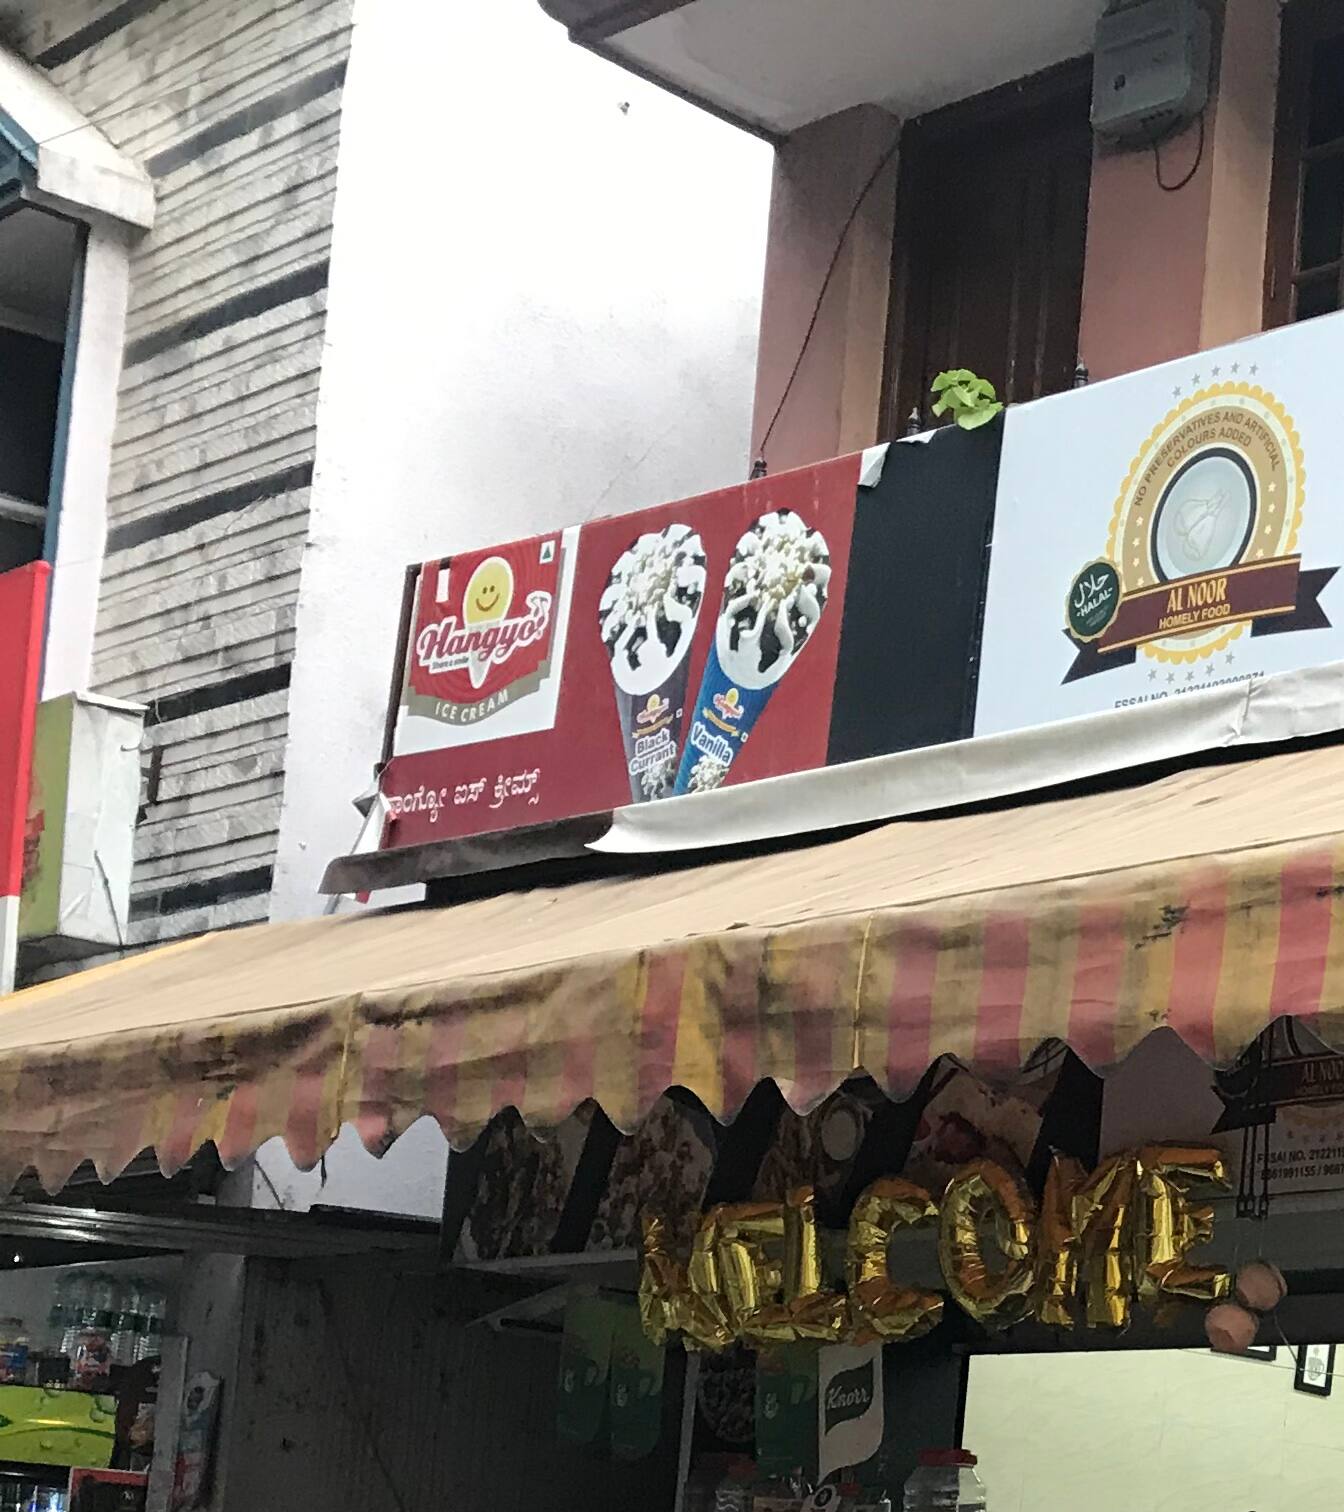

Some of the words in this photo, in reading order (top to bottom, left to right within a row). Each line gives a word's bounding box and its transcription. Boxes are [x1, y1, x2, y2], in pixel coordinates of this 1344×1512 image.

[1134, 485, 1147, 507] NO
[1144, 411, 1221, 483] PRESERVATIVES
[1222, 411, 1245, 425] AND
[1244, 416, 1281, 472] ARTIFICIAL
[1166, 428, 1216, 469] COLOURS
[1218, 427, 1251, 448] ADDED
[1166, 588, 1184, 613] AL
[1188, 577, 1228, 608] NOOR
[416, 594, 552, 665] Hangyo
[1158, 611, 1200, 630] HOMELY
[1200, 603, 1231, 620] FOOD
[434, 701, 457, 719] ICE
[460, 688, 509, 722] CREAM
[636, 729, 669, 754] Black
[692, 722, 733, 765] Vanilla
[826, 1386, 871, 1411] Knorr
